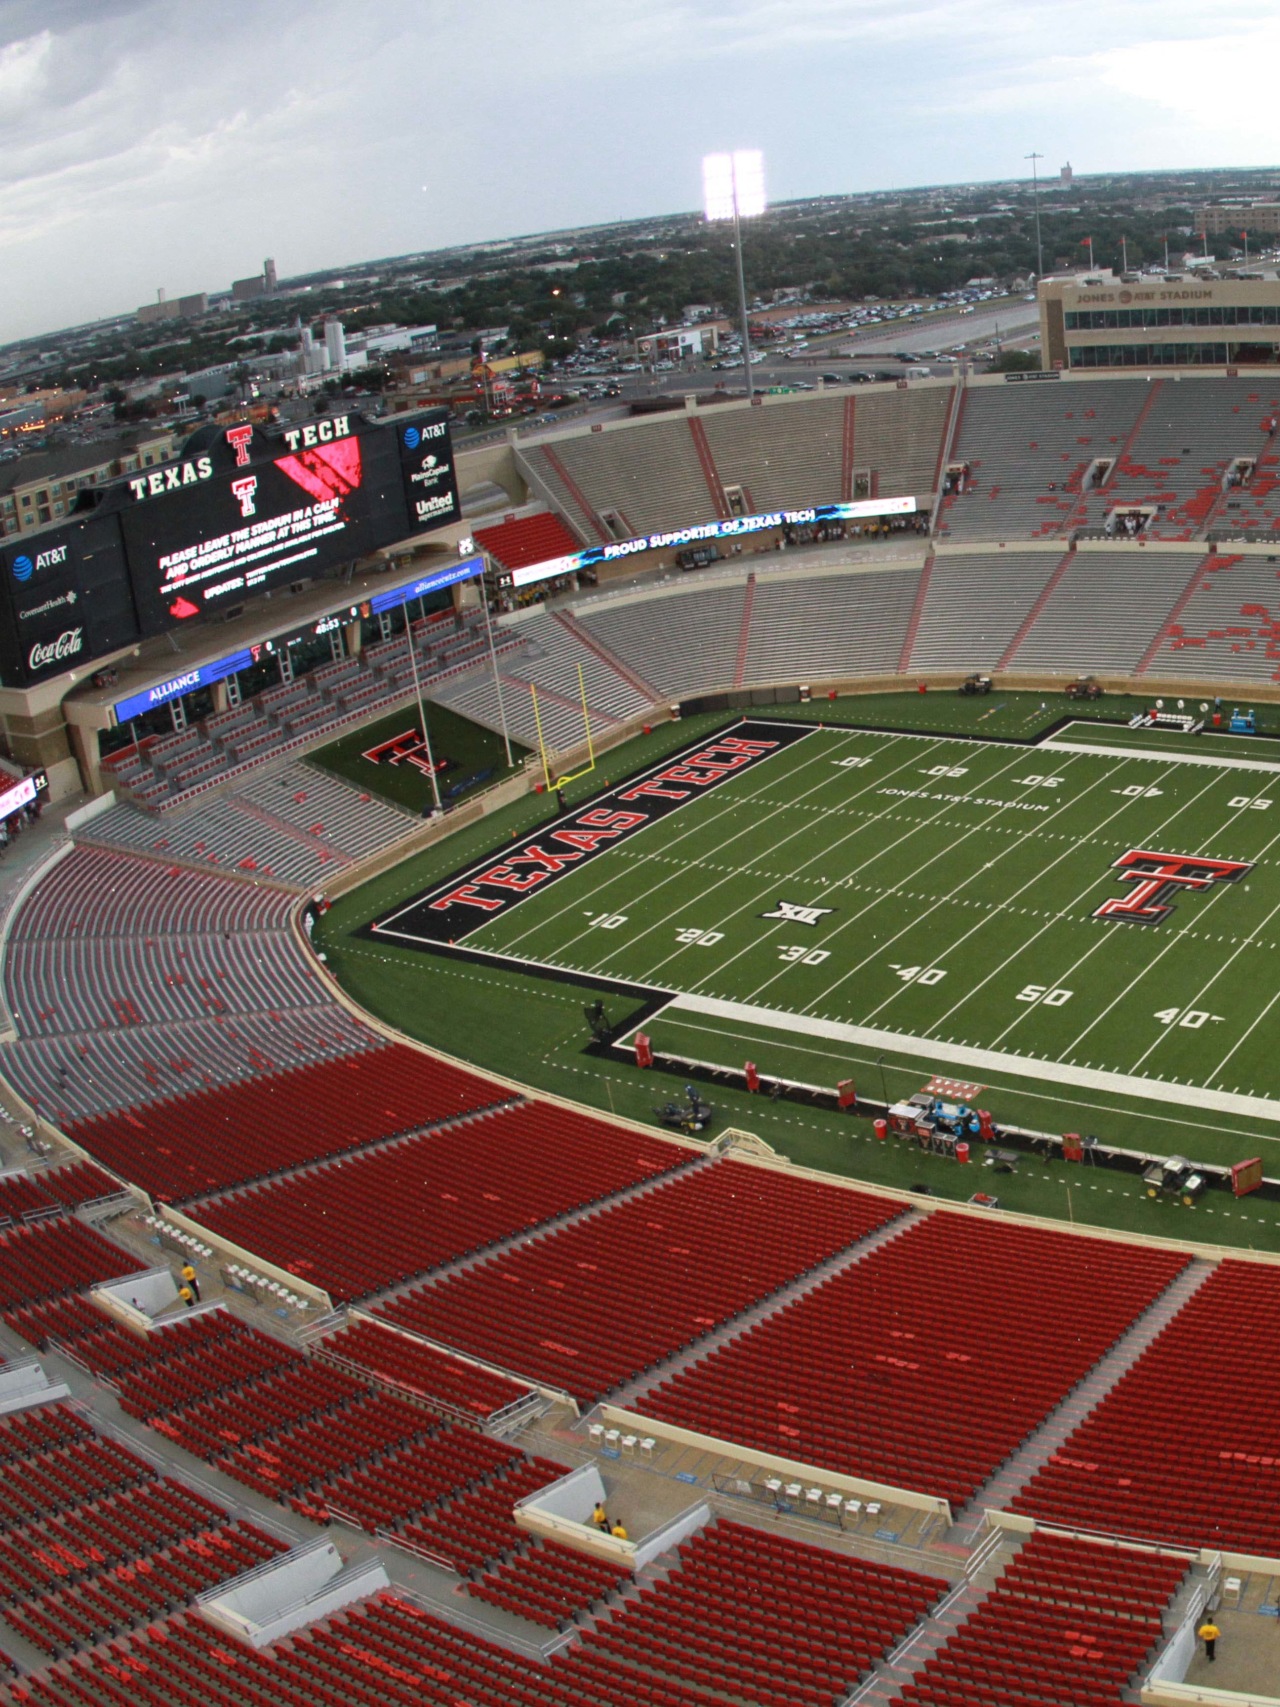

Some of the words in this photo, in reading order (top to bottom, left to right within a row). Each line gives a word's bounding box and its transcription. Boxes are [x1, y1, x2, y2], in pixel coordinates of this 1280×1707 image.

[1077, 294, 1115, 303] JONES
[1160, 290, 1212, 299] STADIUM
[285, 416, 350, 450] TECH
[422, 422, 446, 440] AT&T
[130, 458, 213, 500] TEXAS
[424, 478, 439, 486] Bank
[416, 491, 453, 514] United
[159, 545, 199, 569] PLEASE
[199, 535, 230, 555] LEAVE
[231, 527, 251, 542] THE
[250, 514, 292, 537] STADIUM
[313, 497, 340, 515] CALM
[604, 540, 648, 558] PROUD
[650, 524, 720, 549] SUPPORTER
[723, 520, 741, 532] OF
[743, 513, 783, 528] TEXAS
[784, 510, 816, 522] TECH
[36, 545, 67, 570] AT&T
[165, 562, 190, 580] AND
[190, 549, 235, 571] ORDERLY
[236, 534, 277, 555] MANNER
[277, 528, 290, 540] AT
[291, 518, 313, 536] THIS
[204, 577, 245, 599] UPDATES:
[20, 596, 66, 620] CovenantHealth
[29, 627, 83, 670] Coca-Cola
[150, 671, 200, 701] ALLIANCE
[623, 736, 780, 802] TECH
[876, 787, 929, 798] JONES
[930, 794, 972, 803] AT&T
[973, 798, 1050, 812] STADIUM
[428, 807, 650, 914] TEXAS
[588, 913, 628, 929] 10
[675, 928, 725, 946] 20
[778, 946, 831, 965] 30
[896, 966, 947, 985] 40
[1015, 985, 1074, 1006] 50
[1153, 1008, 1210, 1029] 40
